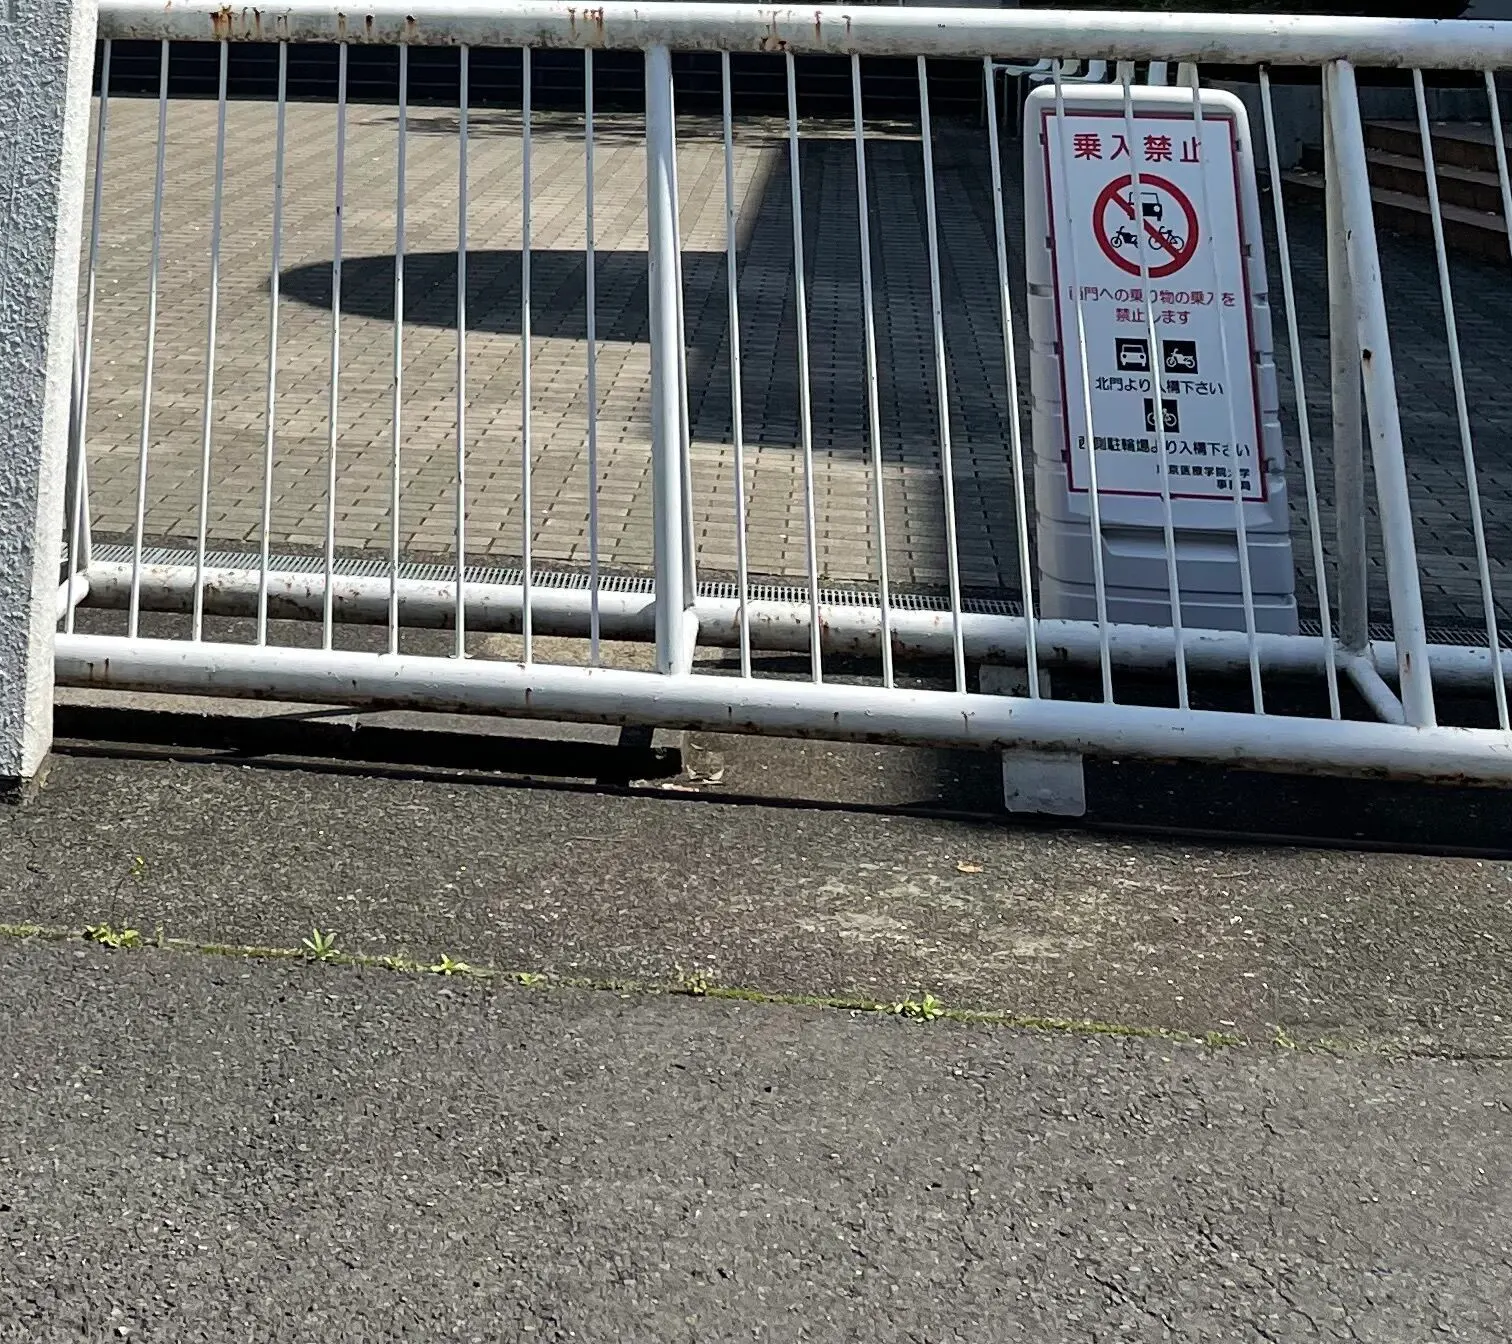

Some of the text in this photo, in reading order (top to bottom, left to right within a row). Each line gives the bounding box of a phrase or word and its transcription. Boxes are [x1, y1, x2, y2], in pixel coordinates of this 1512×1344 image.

[1073, 133, 1201, 163] 乗入禁止
[1156, 464, 1251, 479] 京医療学院学
[1216, 479, 1251, 492] 事局
